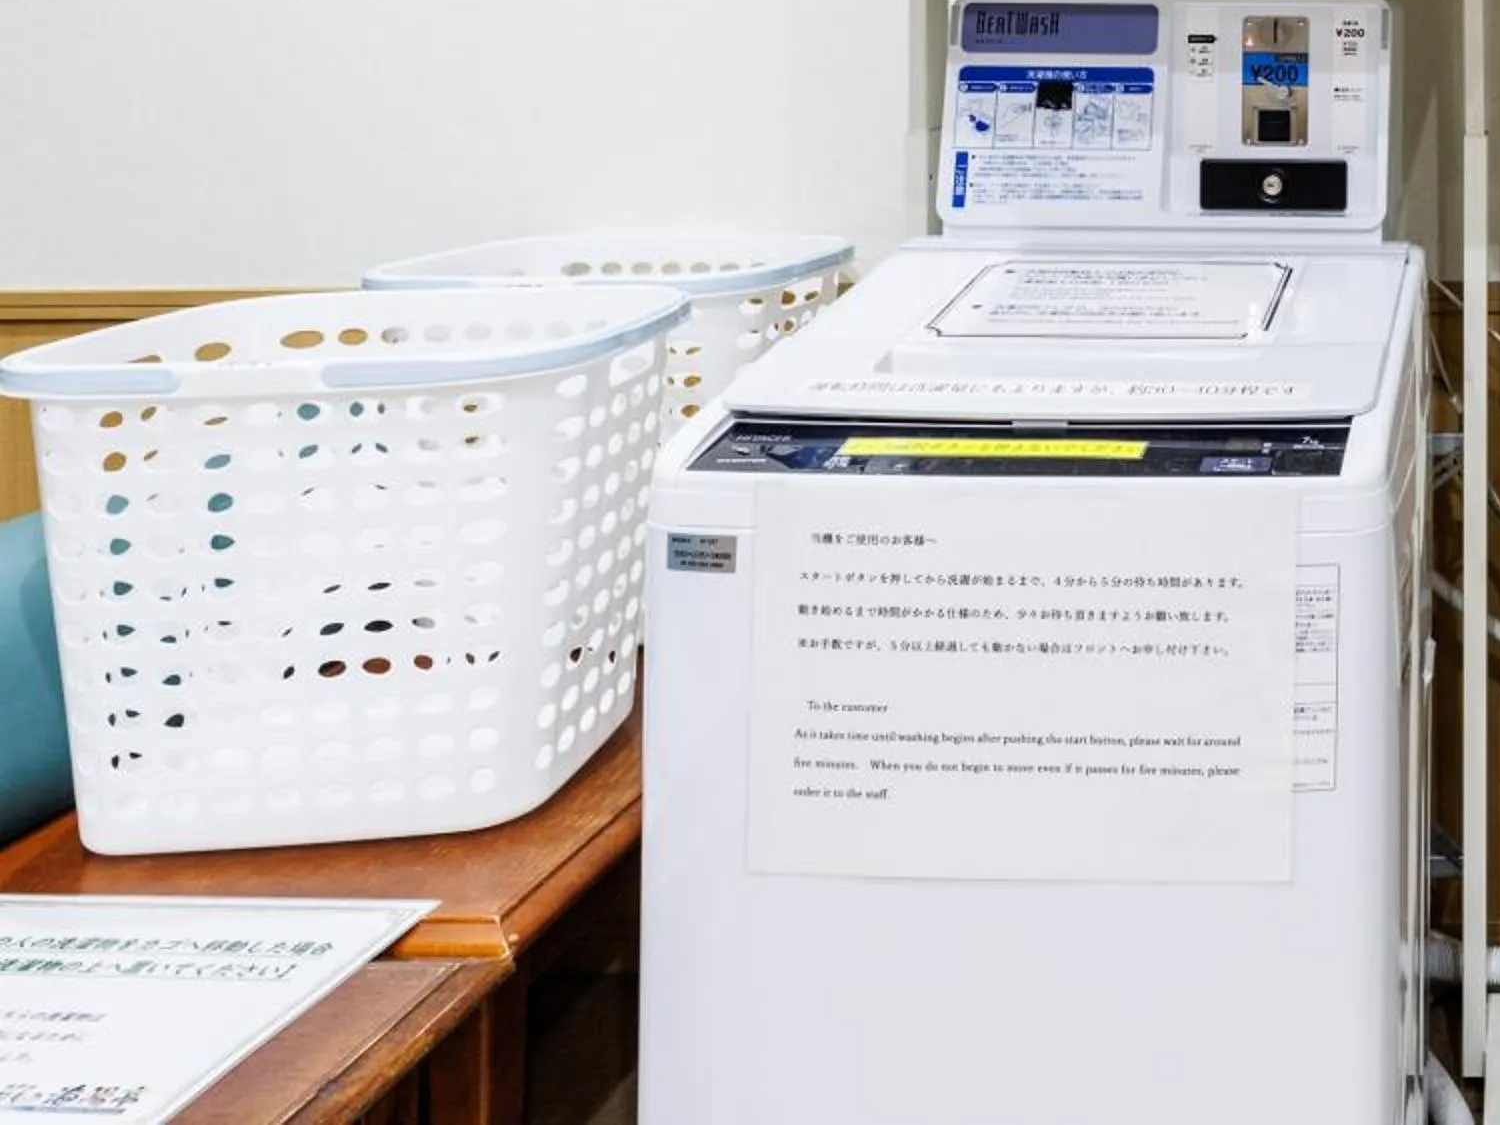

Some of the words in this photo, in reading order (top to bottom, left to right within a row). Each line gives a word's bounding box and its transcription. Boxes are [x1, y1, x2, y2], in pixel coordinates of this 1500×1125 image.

[1251, 65, 1300, 84] ¥200
[811, 532, 937, 548] 当機をご使用のお客様へ
[823, 700, 839, 712] the
[842, 703, 888, 714] customer
[819, 729, 845, 740] takes
[847, 730, 869, 741] time
[871, 730, 897, 742] until
[899, 731, 940, 745] washing
[942, 732, 975, 745] begins
[977, 732, 1001, 743] after
[1003, 733, 1044, 747] pushing
[1046, 733, 1062, 744] the
[1064, 735, 1087, 745] start
[1129, 734, 1160, 748] please
[1163, 735, 1184, 746] wait
[1204, 735, 1242, 747] around
[794, 757, 812, 768] five
[870, 758, 900, 771] When
[904, 761, 922, 773] you
[961, 761, 990, 774] begin
[1037, 764, 1061, 774] even
[1085, 765, 1118, 777] passes
[1139, 763, 1157, 775] five
[1208, 765, 1240, 778] please
